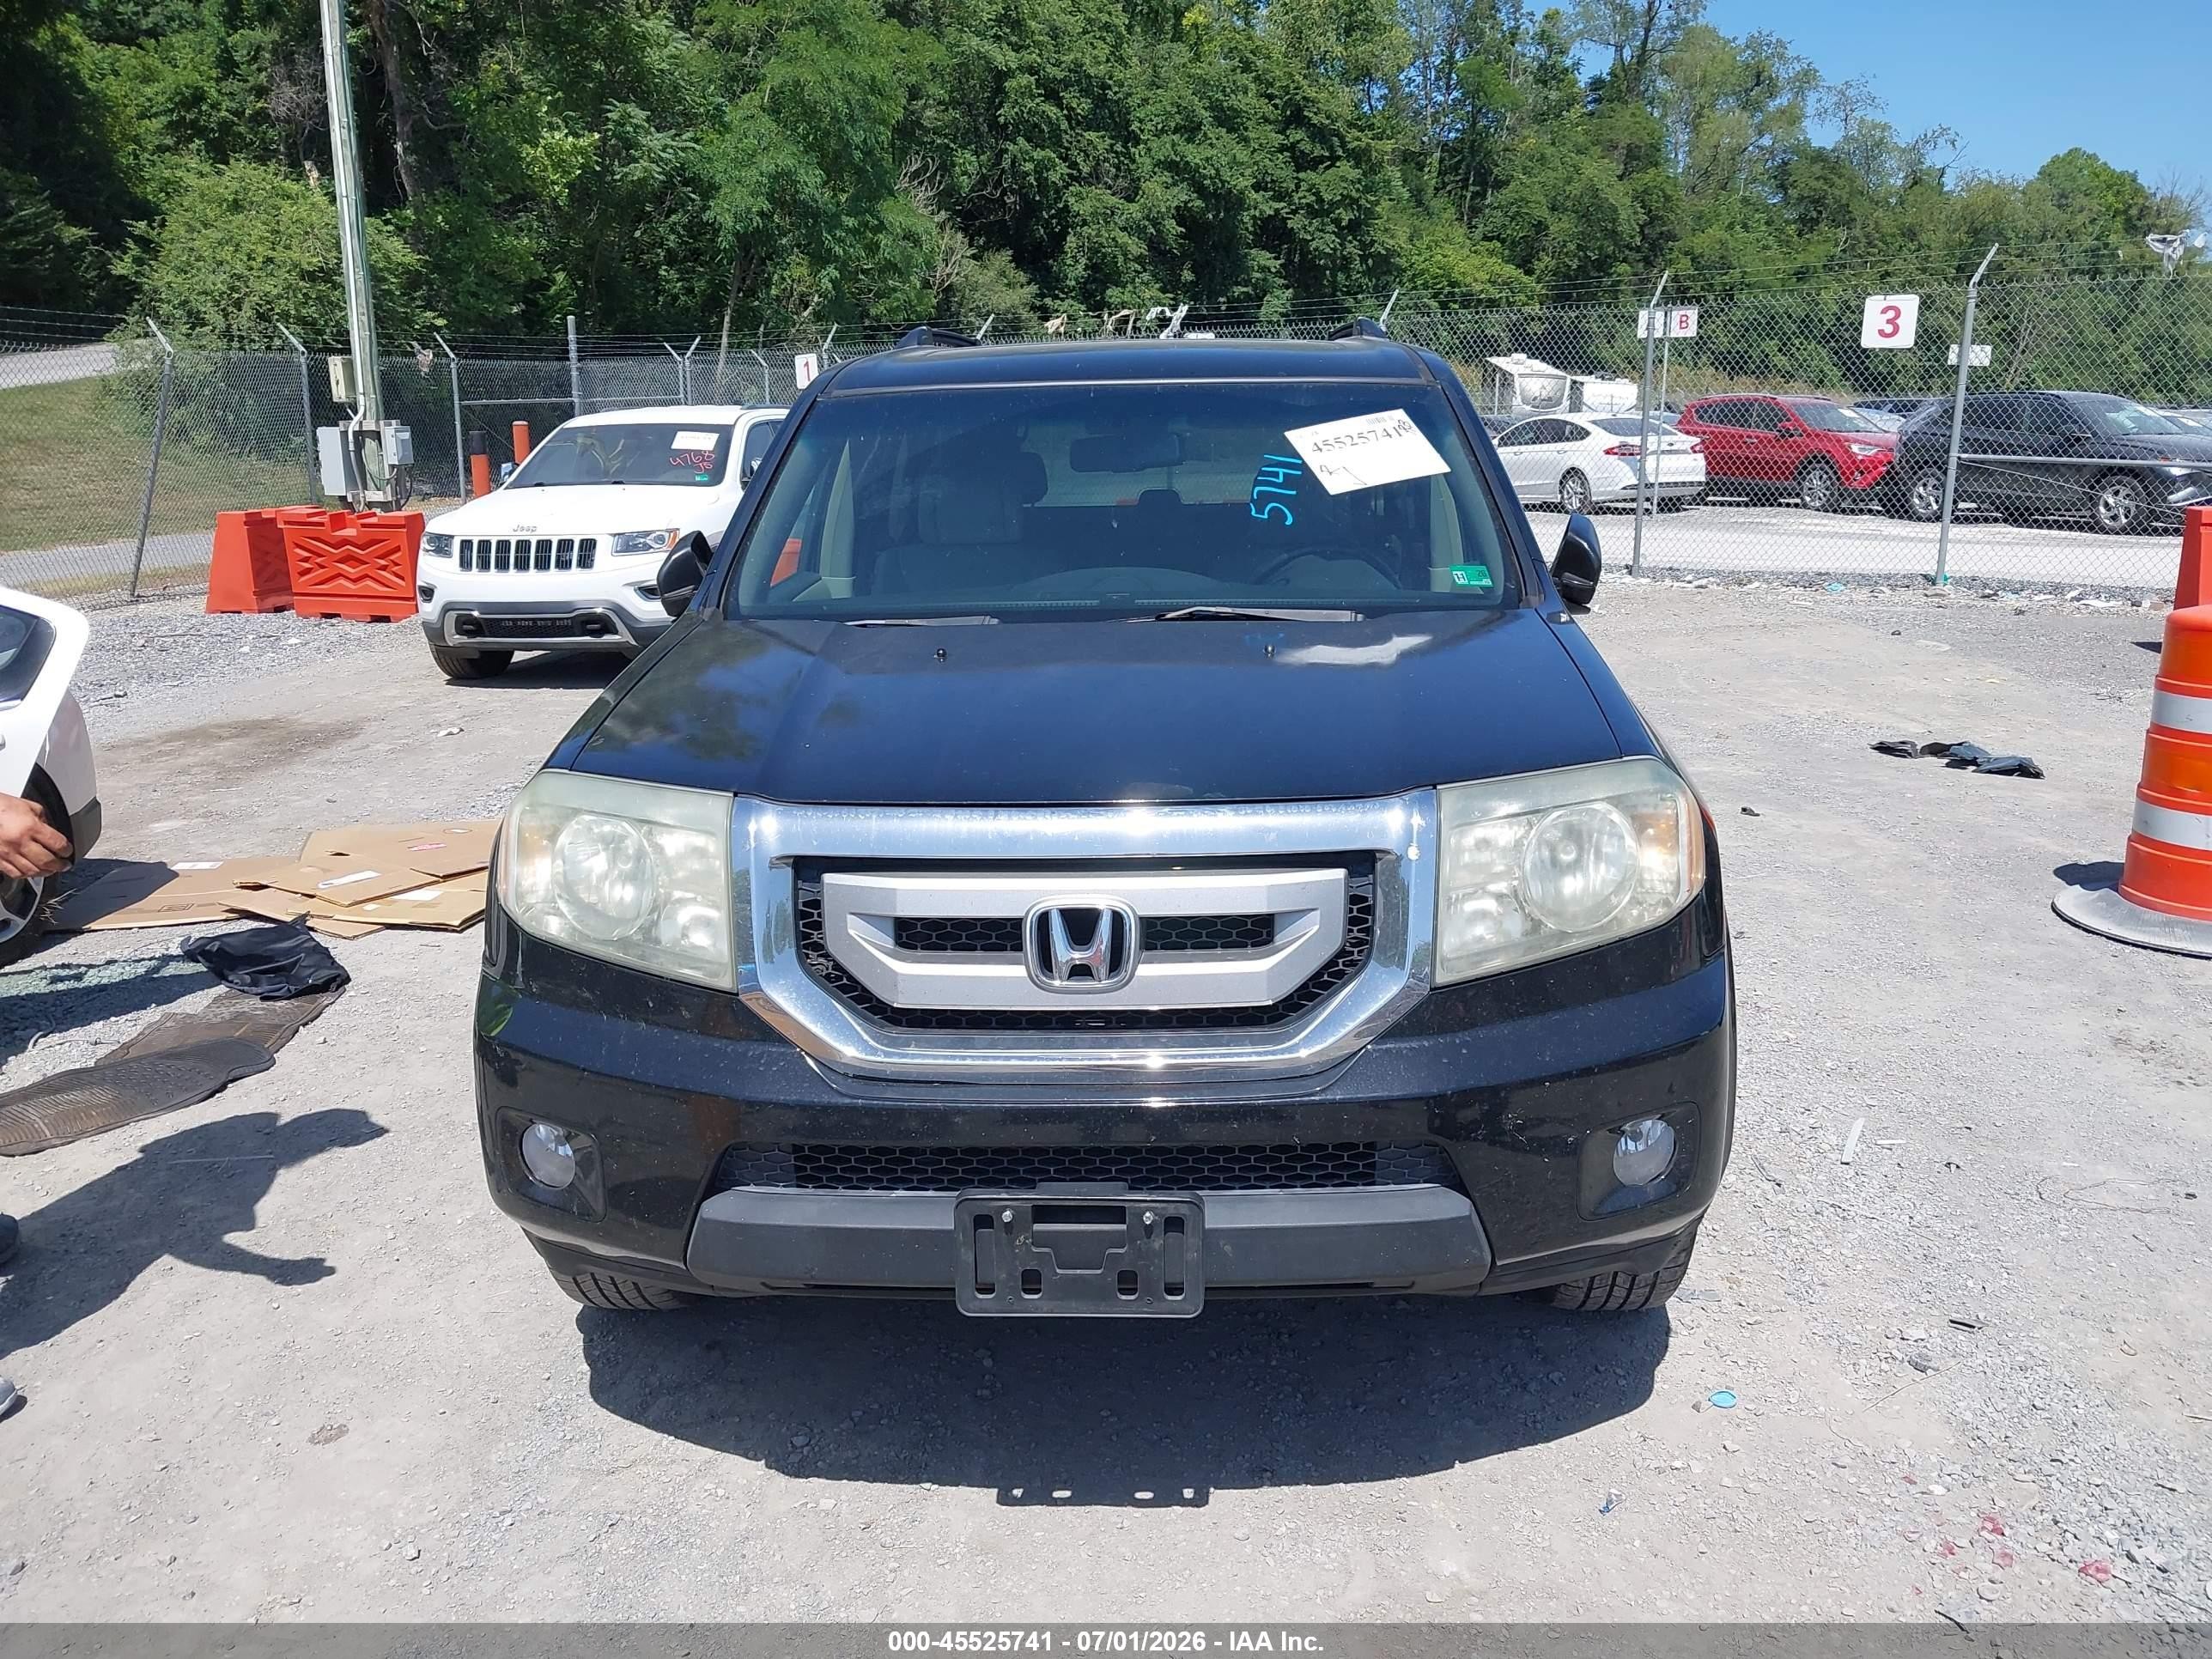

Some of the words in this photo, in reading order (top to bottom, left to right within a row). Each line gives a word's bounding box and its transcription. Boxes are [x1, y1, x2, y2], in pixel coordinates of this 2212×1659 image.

[1679, 314, 1690, 330] B
[1877, 305, 1902, 338] 3
[804, 361, 811, 382] 1
[670, 450, 715, 466] 4768
[1250, 453, 1304, 526] 5741
[513, 524, 538, 533] Jeep
